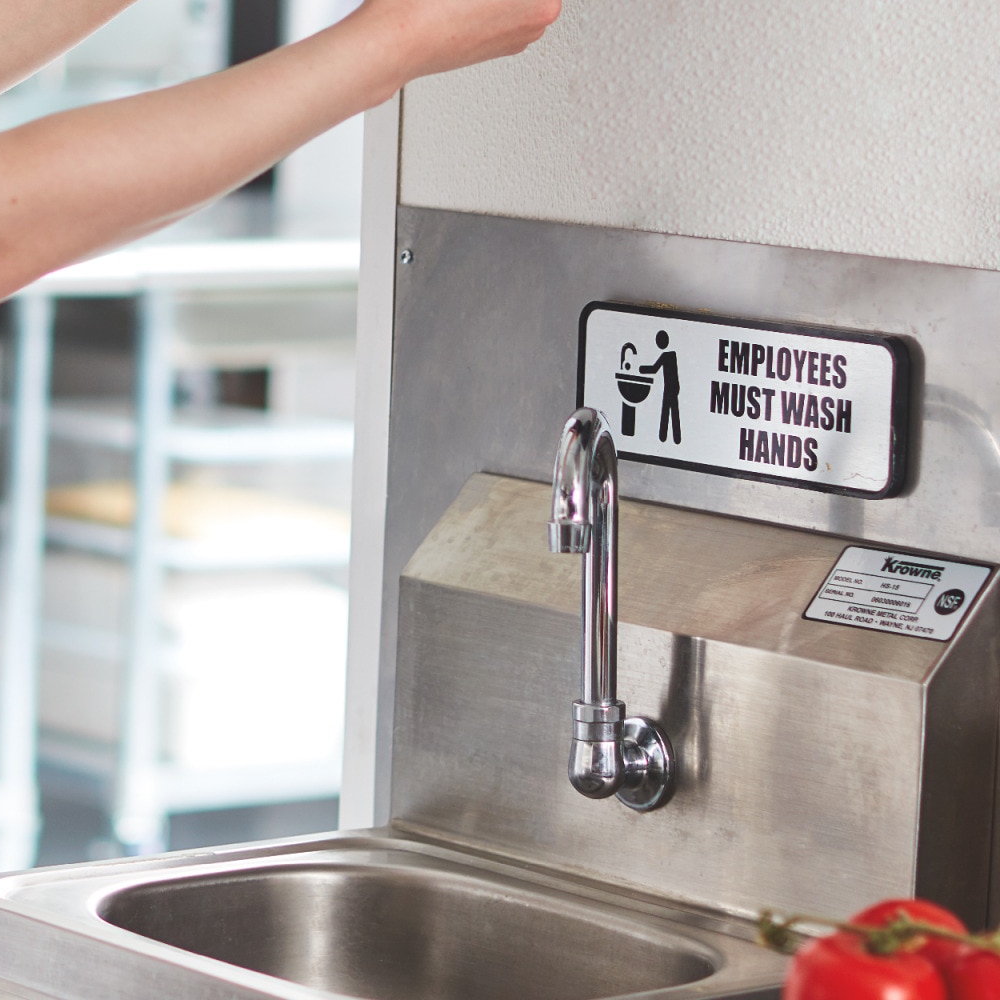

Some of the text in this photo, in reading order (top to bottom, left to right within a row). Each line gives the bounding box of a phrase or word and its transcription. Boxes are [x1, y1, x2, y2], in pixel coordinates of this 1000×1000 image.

[718, 339, 848, 389] EMPLOYEES
[710, 381, 852, 433] MUST WASH
[739, 427, 818, 472] HANDS
[847, 606, 876, 616] KROWNE
[876, 611, 898, 620] METAL
[936, 594, 961, 609] NSF
[854, 616, 874, 624] ROAD
